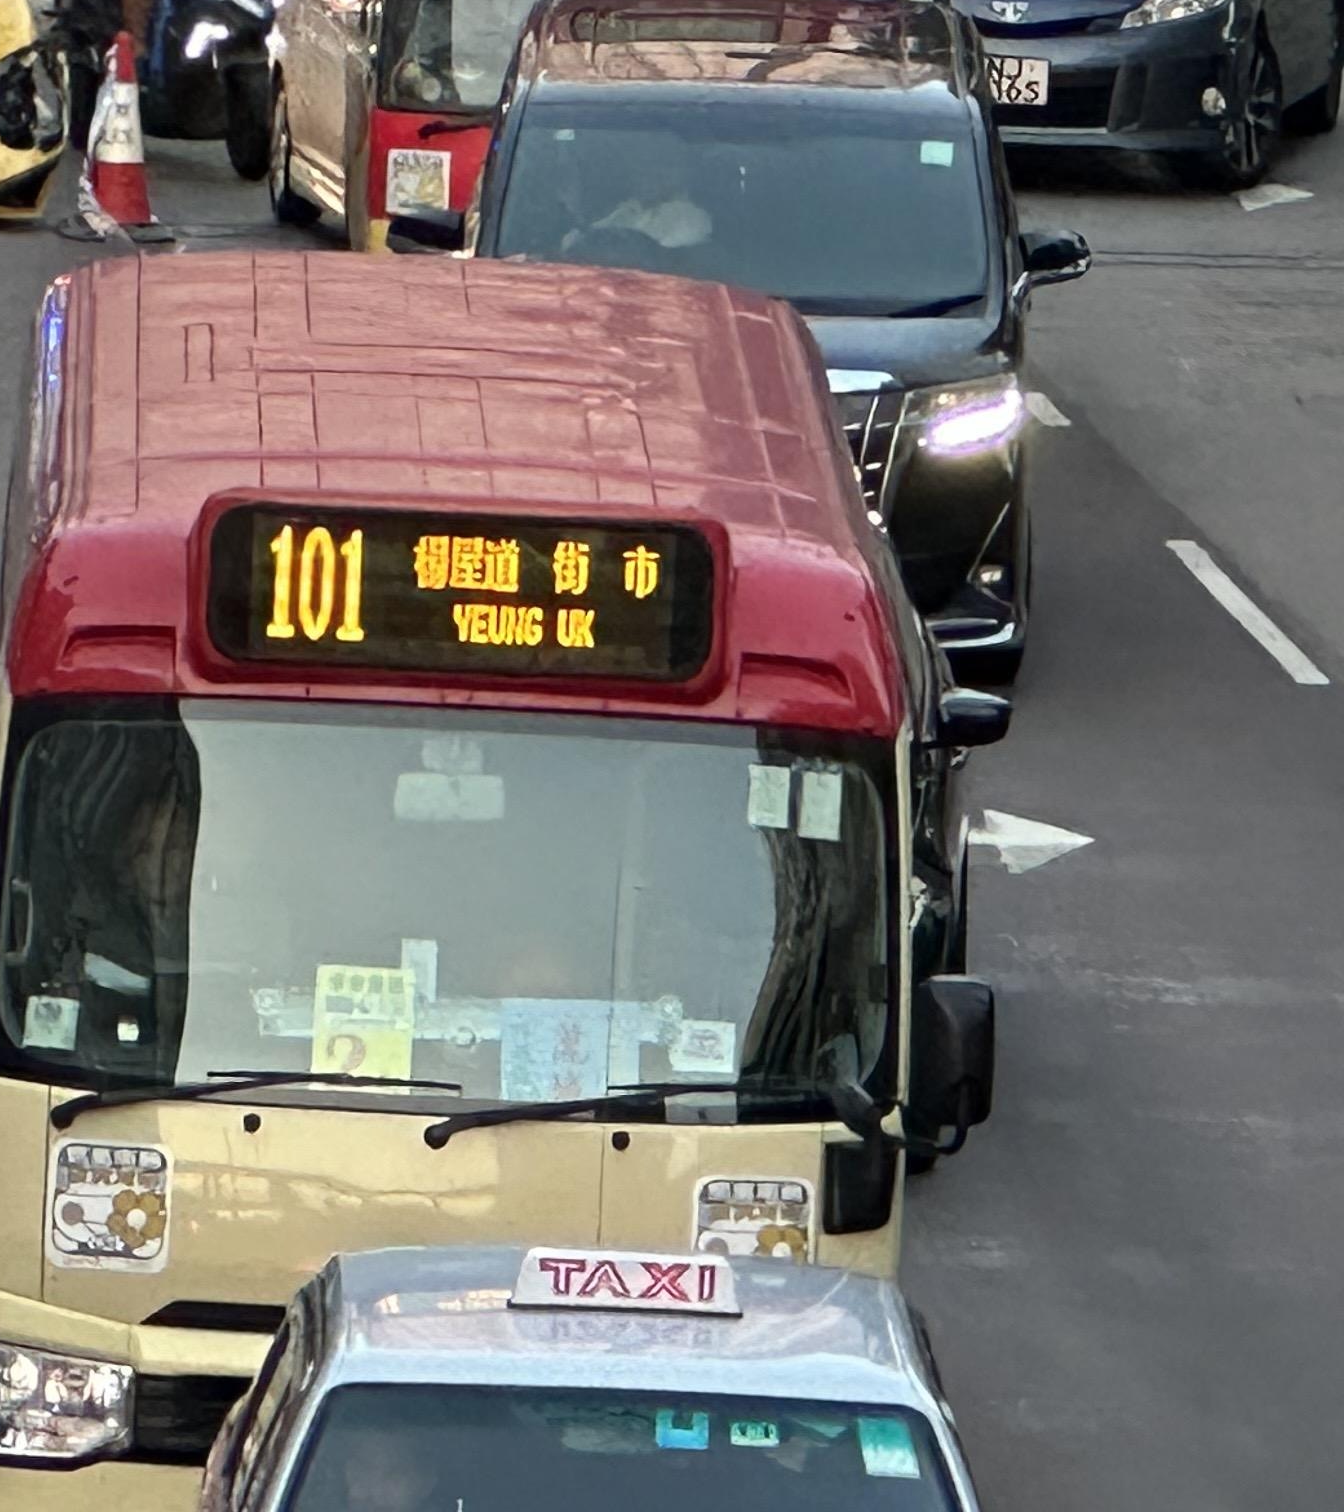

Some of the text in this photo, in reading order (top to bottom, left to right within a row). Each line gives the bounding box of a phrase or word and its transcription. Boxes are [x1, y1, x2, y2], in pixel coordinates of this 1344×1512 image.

[266, 525, 365, 641] 101
[453, 603, 595, 649] YEUNG UK
[538, 1257, 716, 1304] TAXI
